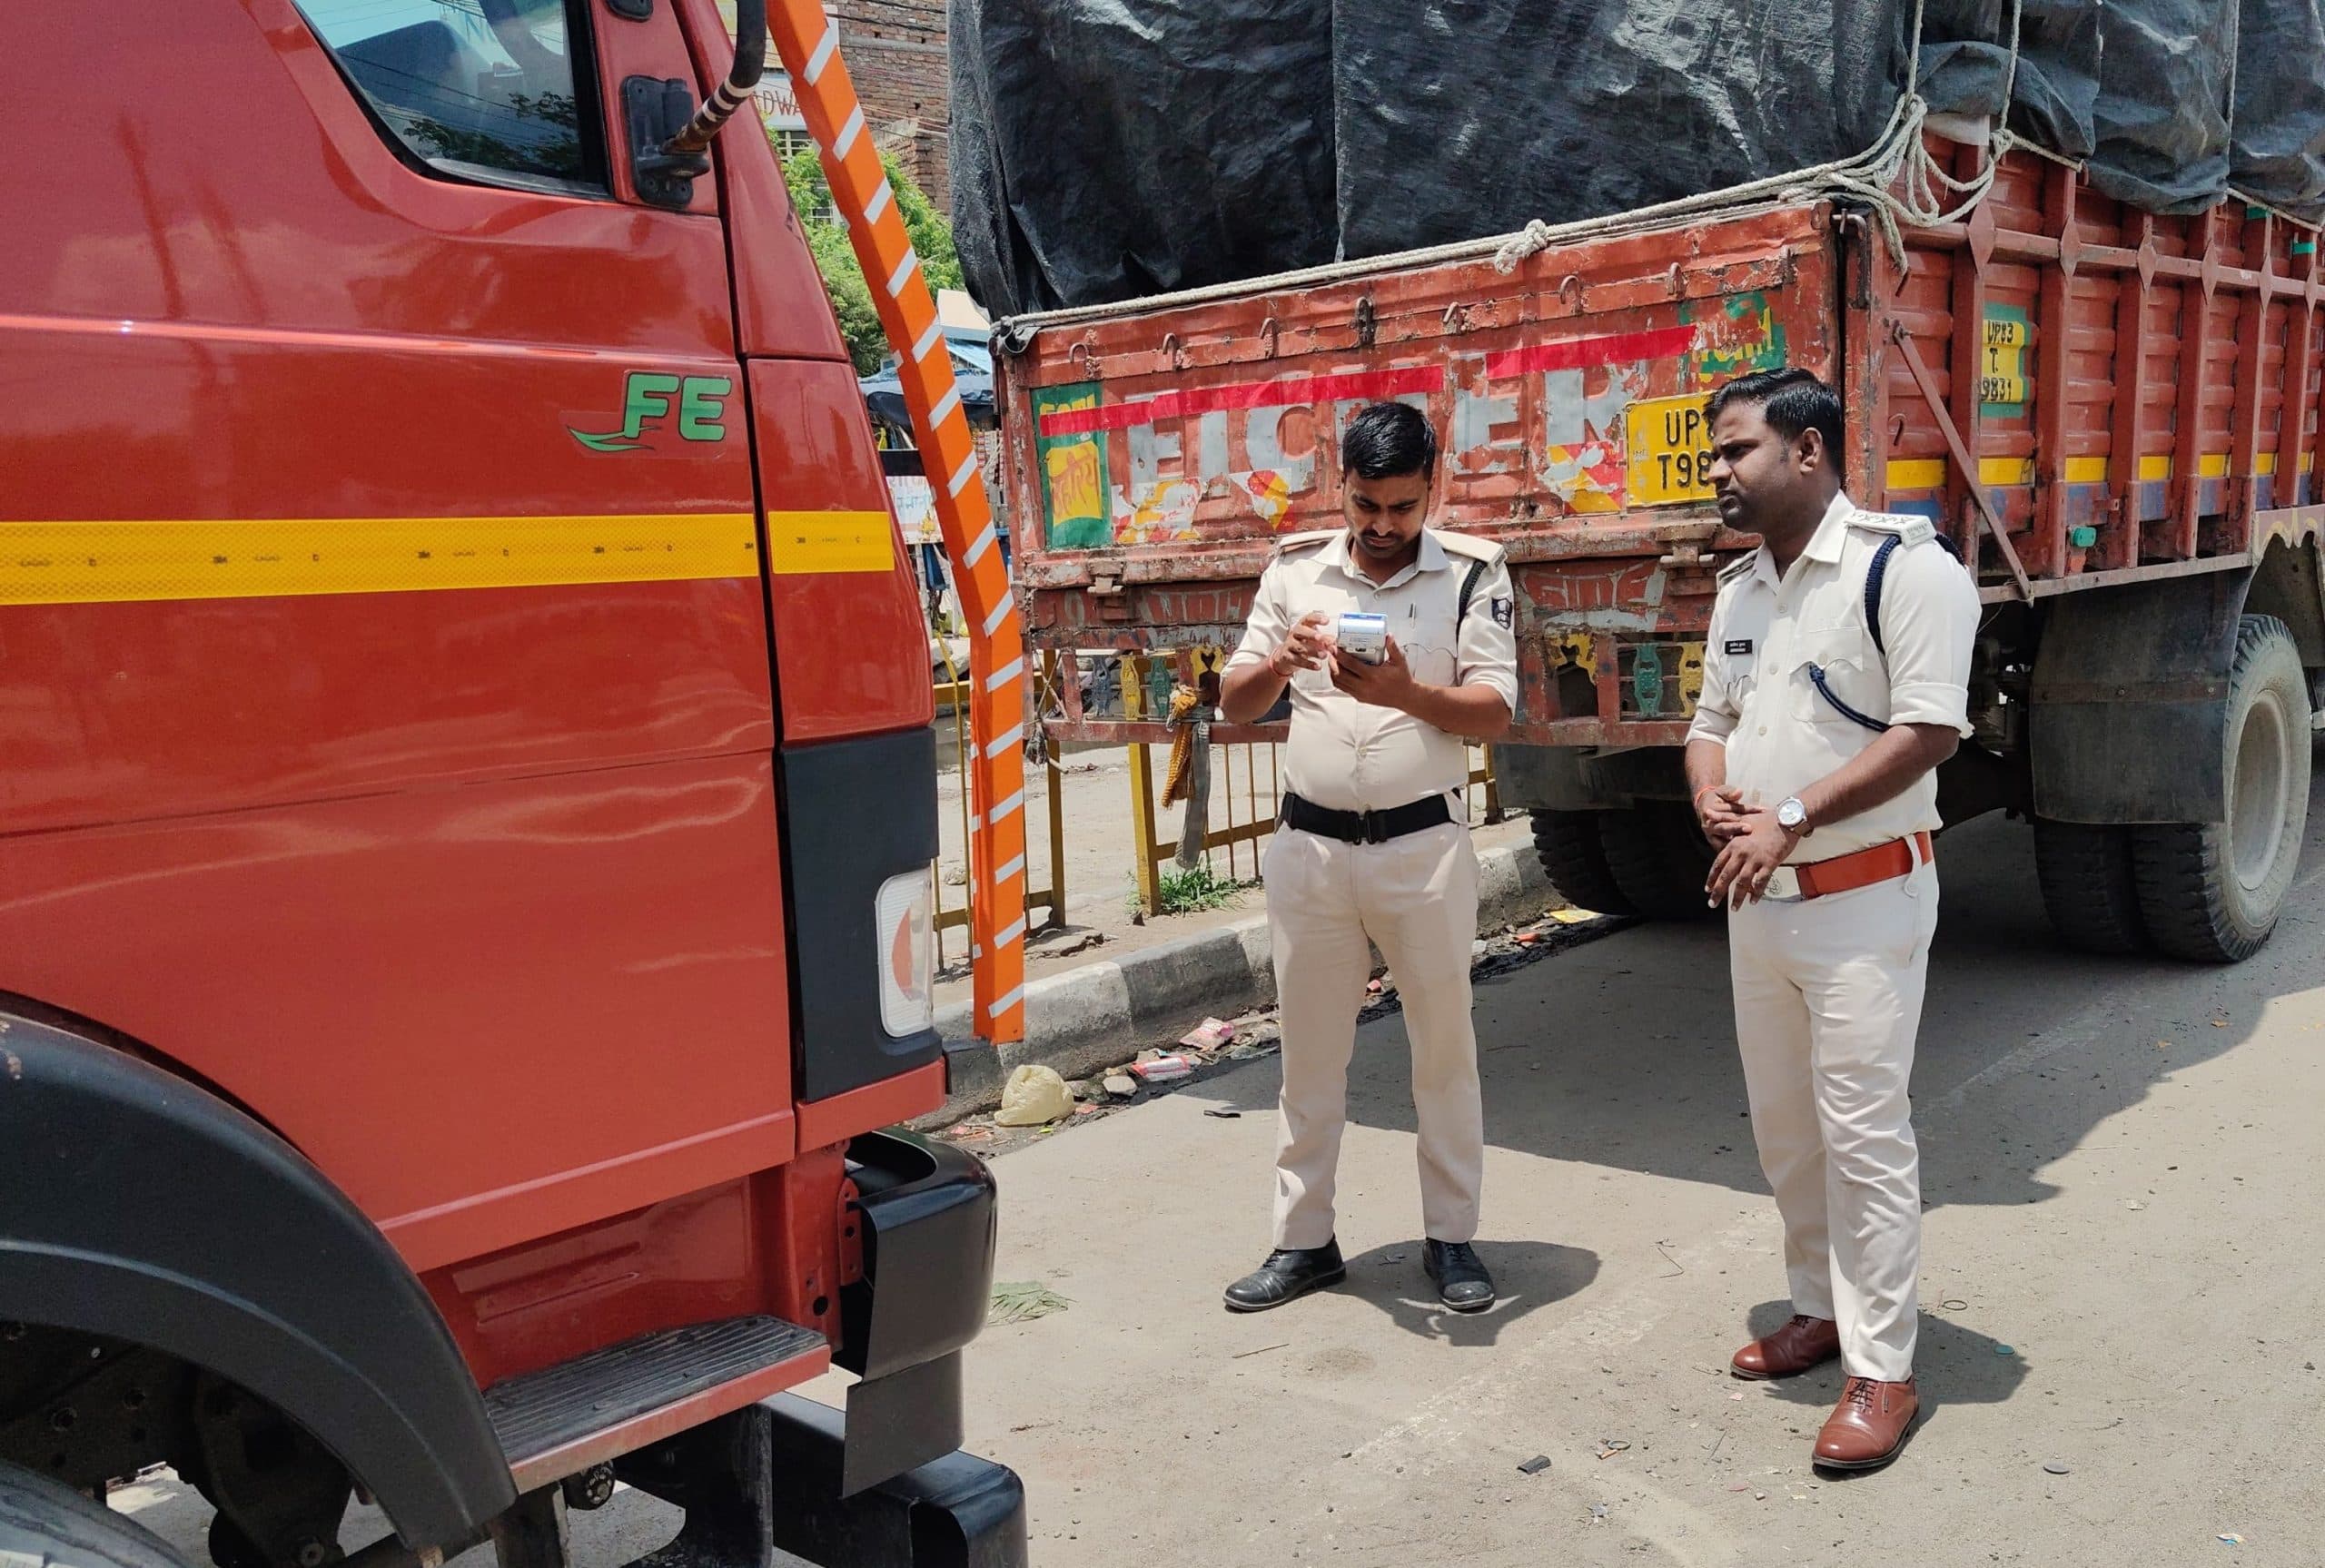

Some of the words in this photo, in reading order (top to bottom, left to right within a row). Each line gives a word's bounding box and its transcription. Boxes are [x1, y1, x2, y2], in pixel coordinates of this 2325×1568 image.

[623, 372, 732, 441] FE
[1124, 334, 1648, 505] EICER
[1665, 408, 1715, 447] UP
